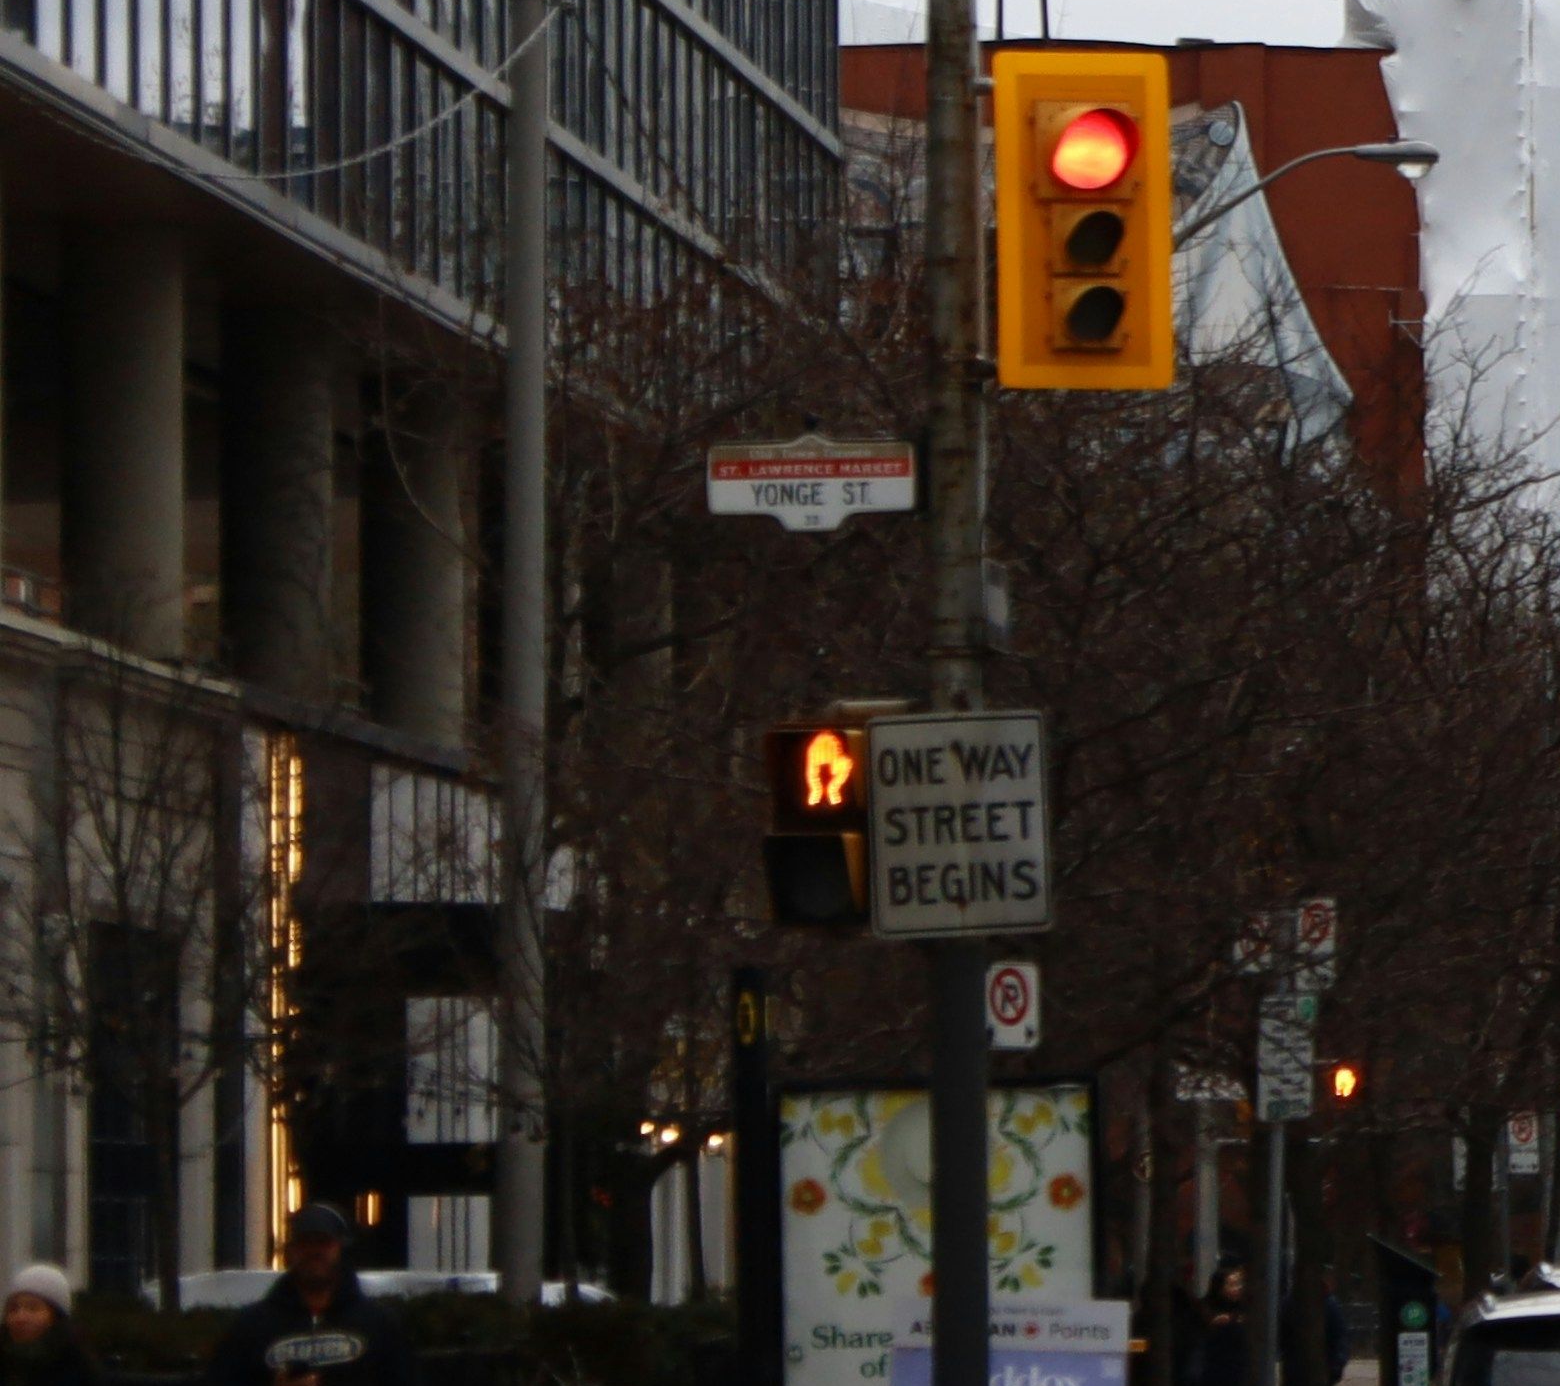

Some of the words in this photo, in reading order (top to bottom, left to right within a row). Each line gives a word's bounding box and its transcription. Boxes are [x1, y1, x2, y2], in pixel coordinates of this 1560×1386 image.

[750, 462, 833, 477] LAWRENCE
[839, 461, 903, 475] MARKET
[751, 482, 826, 506] YONGE
[877, 746, 947, 788] ONE
[951, 741, 1034, 783] WAY
[883, 799, 1036, 847] STREET
[887, 859, 1038, 907] BEGINS
[812, 1325, 893, 1350] Share
[860, 1353, 888, 1379] of
